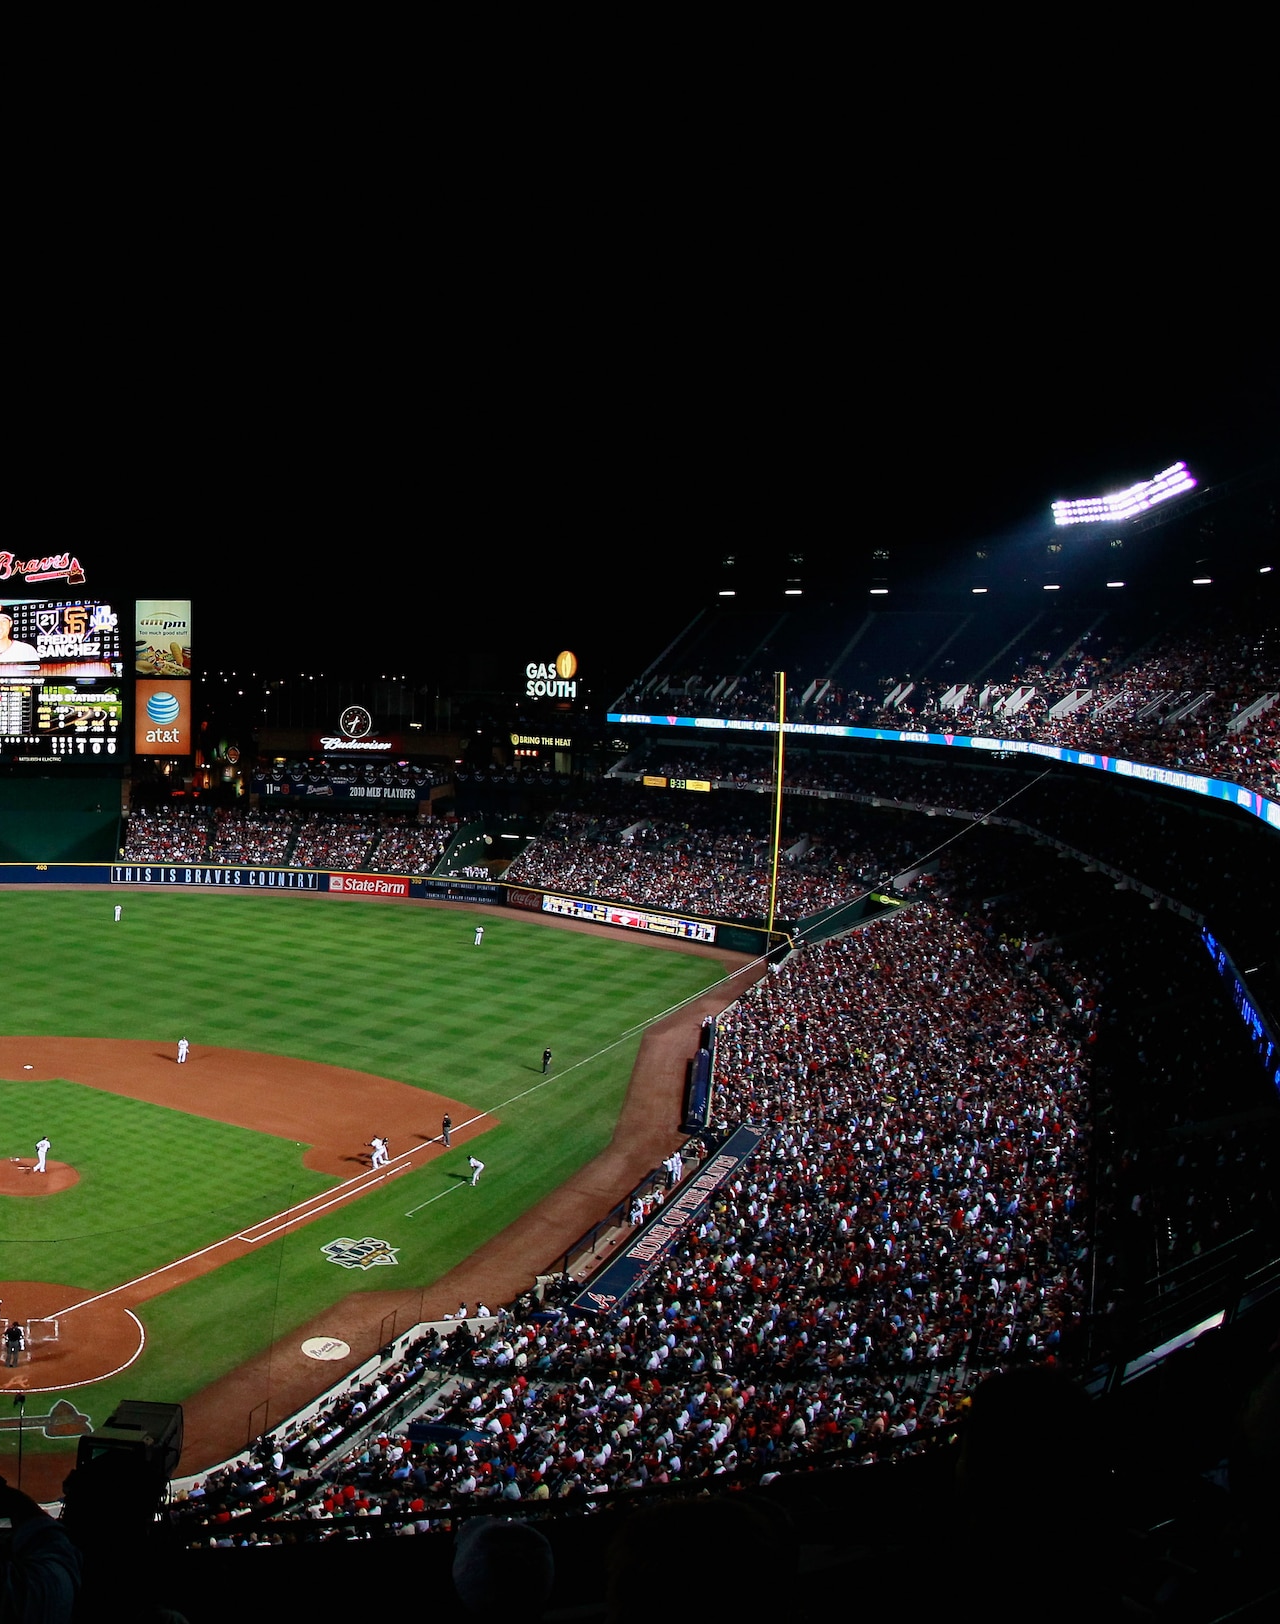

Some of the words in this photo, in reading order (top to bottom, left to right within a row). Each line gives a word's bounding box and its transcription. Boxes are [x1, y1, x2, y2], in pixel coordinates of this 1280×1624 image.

[140, 619, 186, 629] ampm
[37, 634, 85, 646] FREDDY
[37, 643, 101, 658] SANCHEZ
[526, 663, 557, 679] GAS
[525, 681, 576, 698] SOUTH
[146, 728, 180, 742] at&t
[726, 719, 754, 730] AIRLINE
[754, 720, 765, 730] OF
[766, 721, 780, 731] THE
[816, 725, 846, 736] BRAVES
[320, 737, 392, 750] Budweiser
[519, 735, 540, 744] BRING
[541, 737, 553, 745] THE
[554, 738, 572, 746] HEAT
[77, 743, 84, 753] 1
[92, 743, 100, 754] 0
[107, 743, 116, 754] 0
[349, 787, 365, 797] 2010
[366, 787, 381, 797] MLB
[383, 788, 416, 799] PLAYOFFS
[116, 867, 151, 881] THIS
[161, 868, 176, 882] IS
[185, 869, 241, 884] BRAVES
[249, 871, 314, 888] COUNTRY
[692, 1154, 739, 1190] BRAVES
[673, 1187, 710, 1210] THE
[661, 1207, 691, 1226] OF
[626, 1223, 677, 1261] HOME
